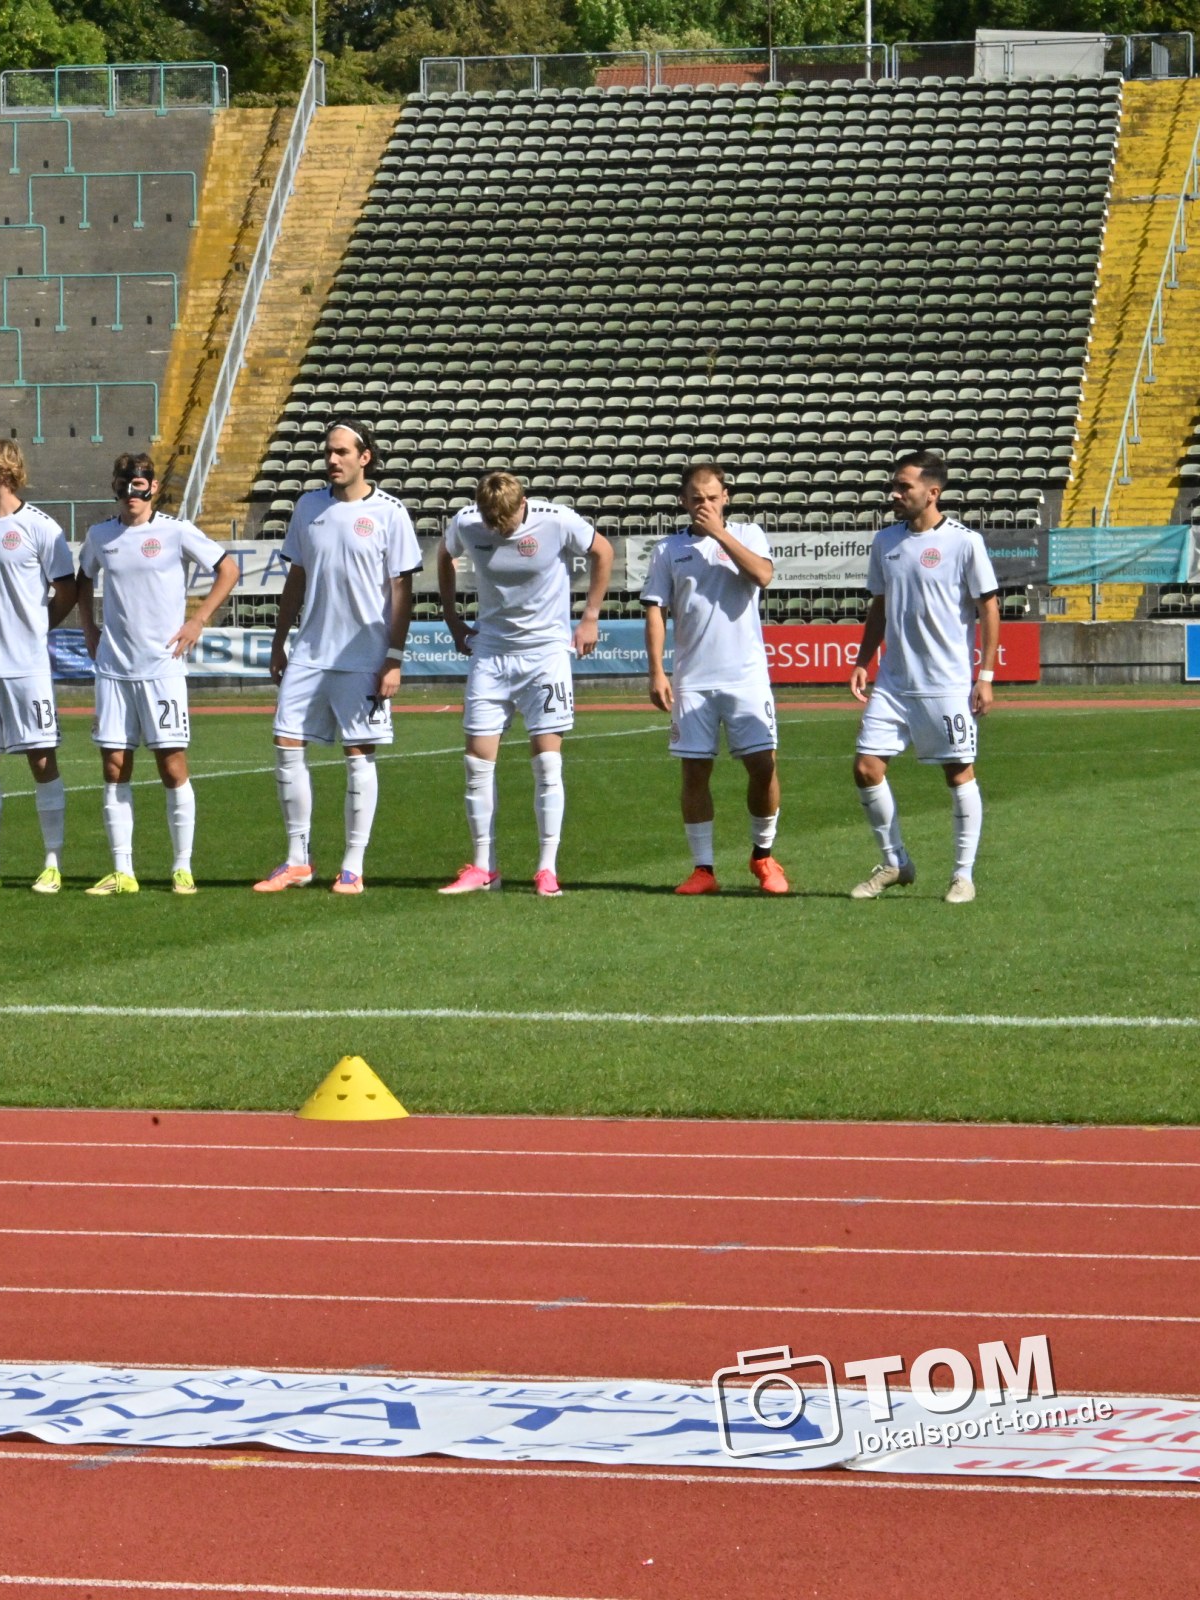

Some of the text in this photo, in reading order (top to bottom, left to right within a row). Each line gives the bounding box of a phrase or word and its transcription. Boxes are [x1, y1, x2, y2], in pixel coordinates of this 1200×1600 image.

[988, 547, 1039, 558] betechnik
[844, 572, 868, 580] Meiste
[434, 632, 455, 644] Ko
[403, 650, 471, 662] Steuerber
[765, 642, 861, 666] essing
[542, 681, 567, 713] 24
[32, 699, 54, 730] 13
[157, 699, 180, 729] 21
[764, 701, 774, 730] 9
[942, 713, 967, 745] 19
